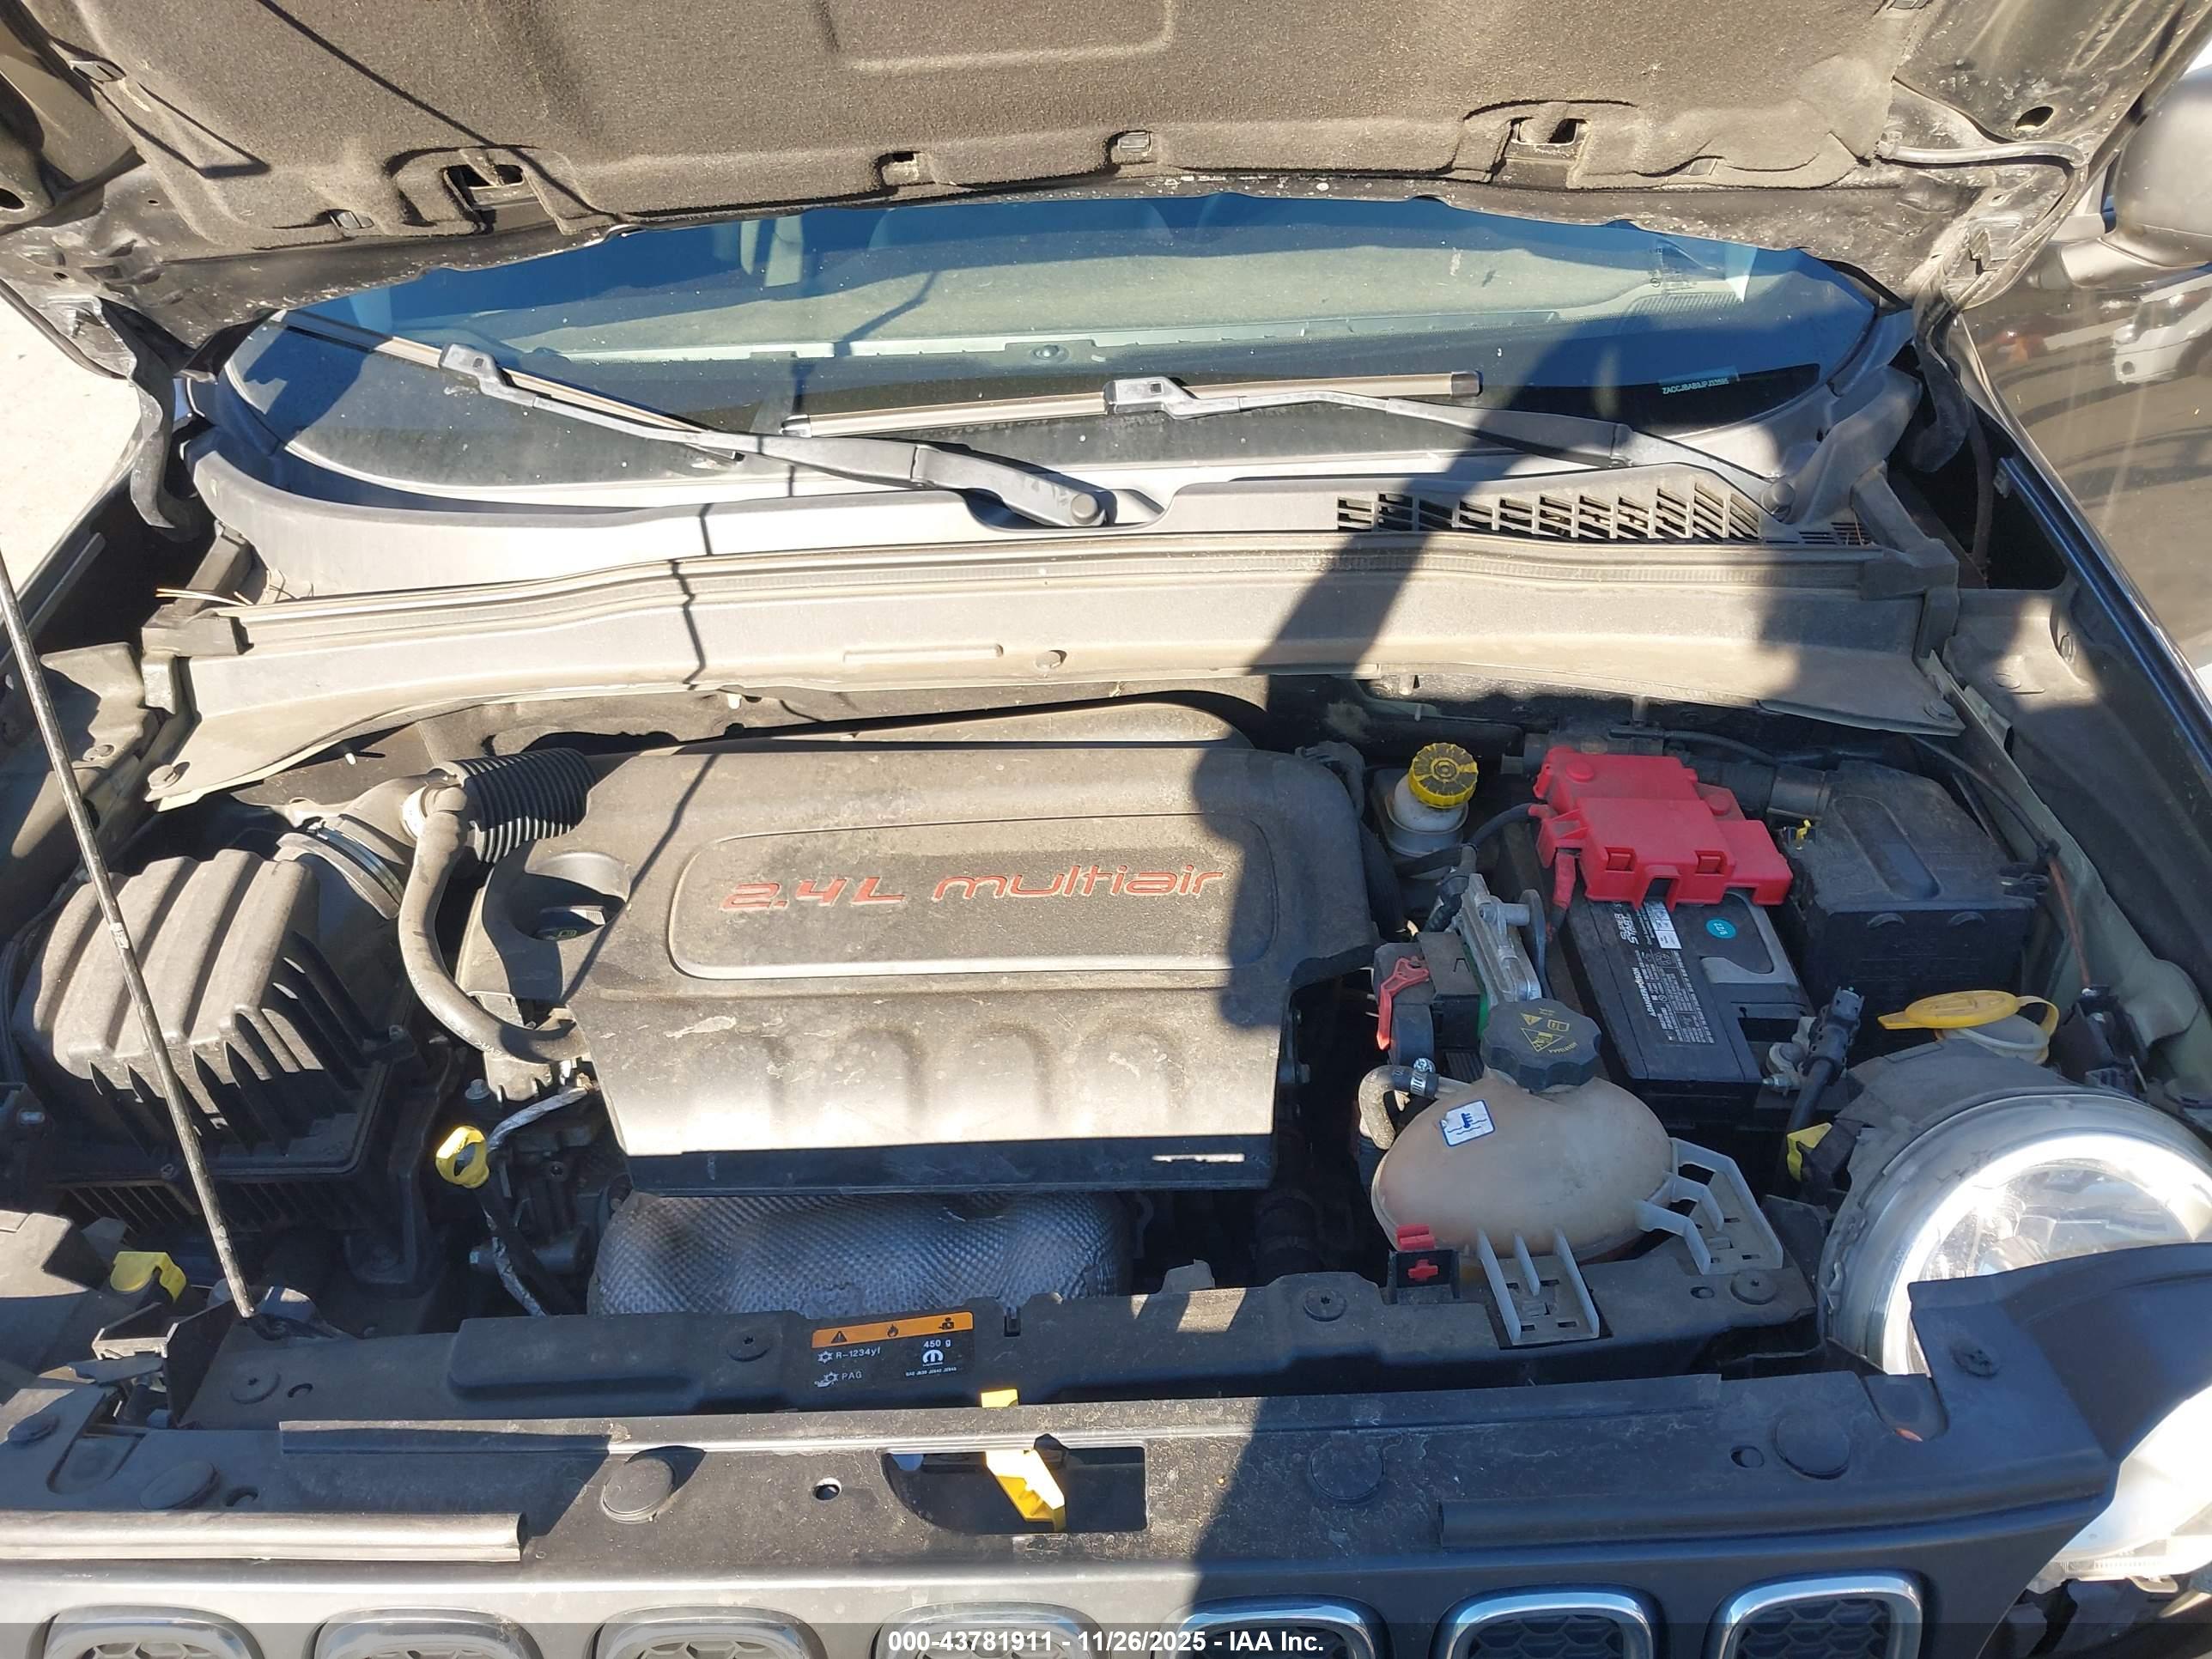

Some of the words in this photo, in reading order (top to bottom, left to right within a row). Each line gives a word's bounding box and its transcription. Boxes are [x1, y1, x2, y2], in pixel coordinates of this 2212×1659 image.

[720, 875, 907, 911] 2.4L
[933, 864, 1224, 902] multiair
[1614, 913, 1628, 940] SUPER
[1621, 913, 1639, 945] START
[1632, 967, 1645, 988] POISON
[1639, 986, 1655, 1014] DANGER
[923, 1339, 942, 1348] 450
[945, 1339, 951, 1348] g
[842, 1370, 863, 1381] PAG
